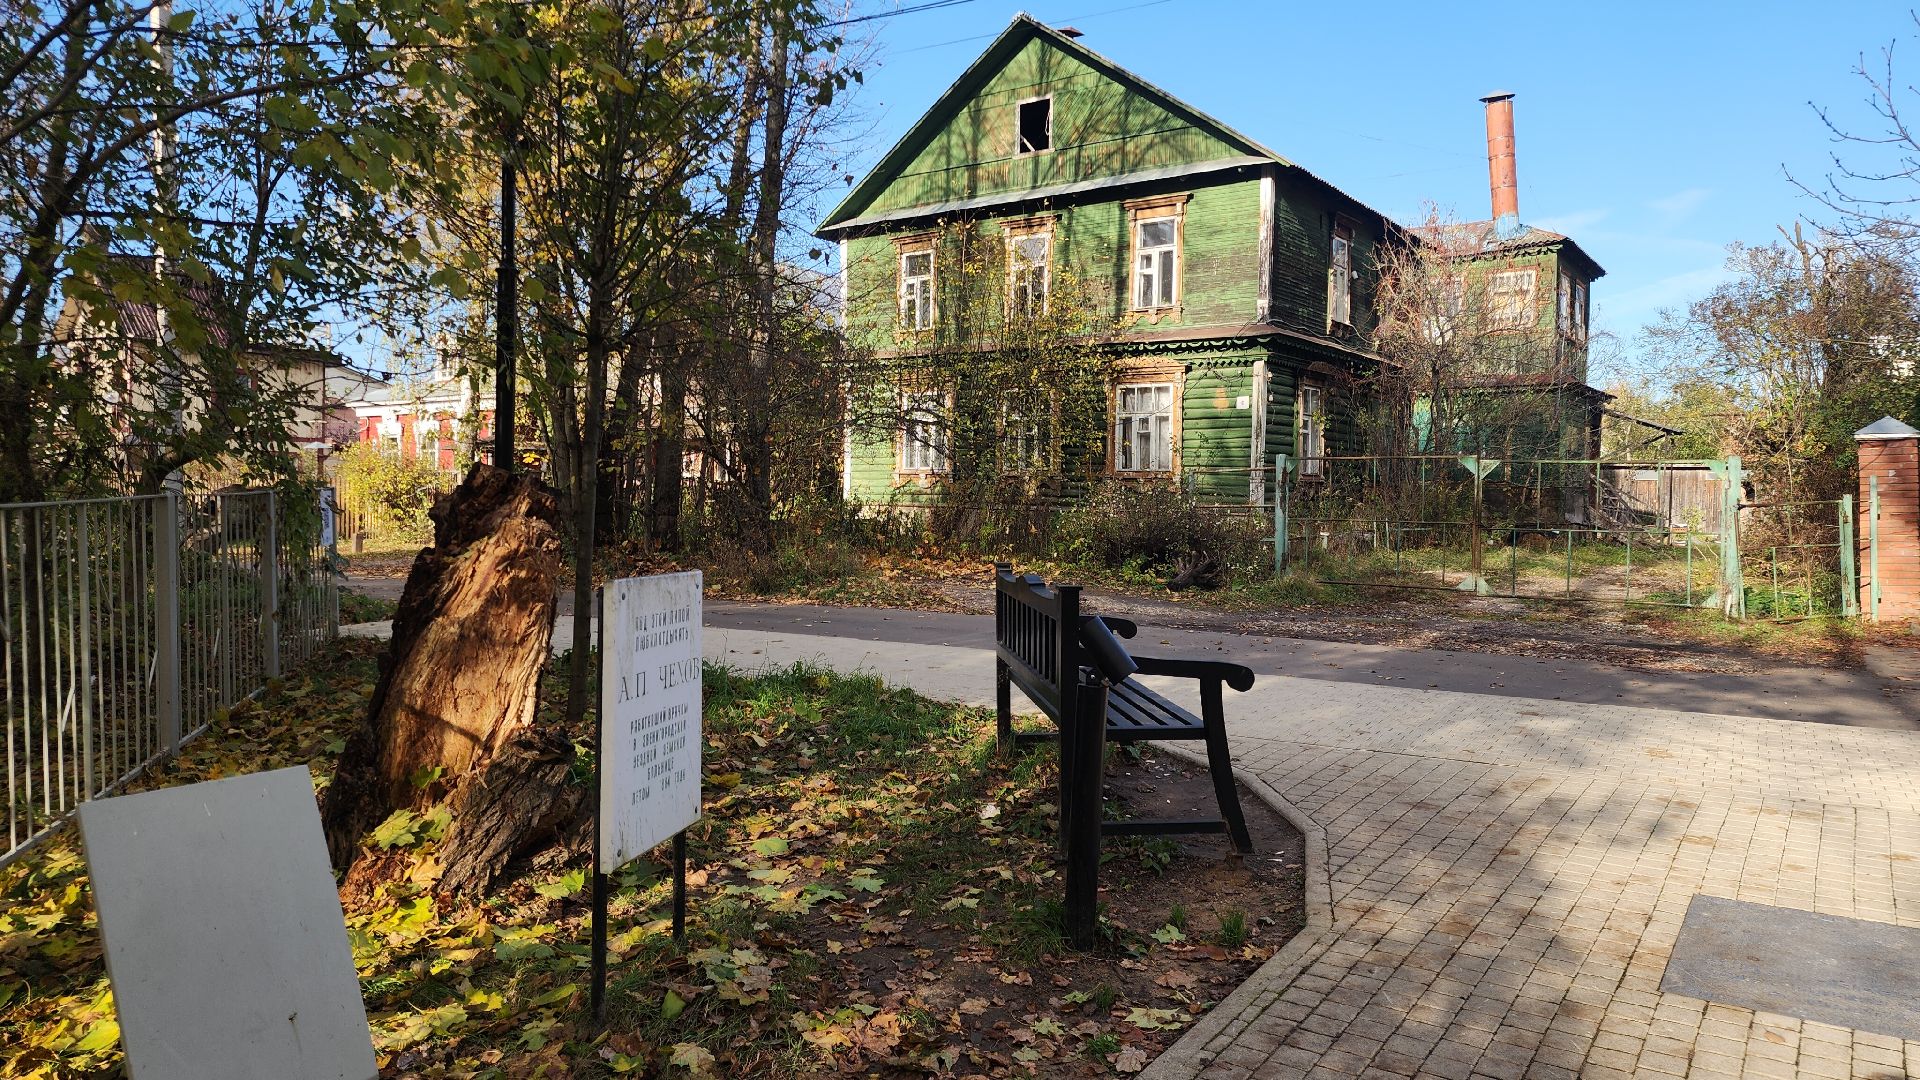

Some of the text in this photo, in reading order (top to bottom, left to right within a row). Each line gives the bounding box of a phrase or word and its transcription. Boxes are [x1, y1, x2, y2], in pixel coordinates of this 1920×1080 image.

[651, 608, 667, 629] ЭТОЙ
[669, 604, 690, 625] ЛИПОЙ
[659, 657, 700, 690] ЧЕХОВ
[630, 703, 689, 735] РАБОТАВШИЙ ВРАЧОМ
[647, 756, 674, 781] БОЛЬНИЦЕ
[632, 785, 650, 806] ЛЕТОМ
